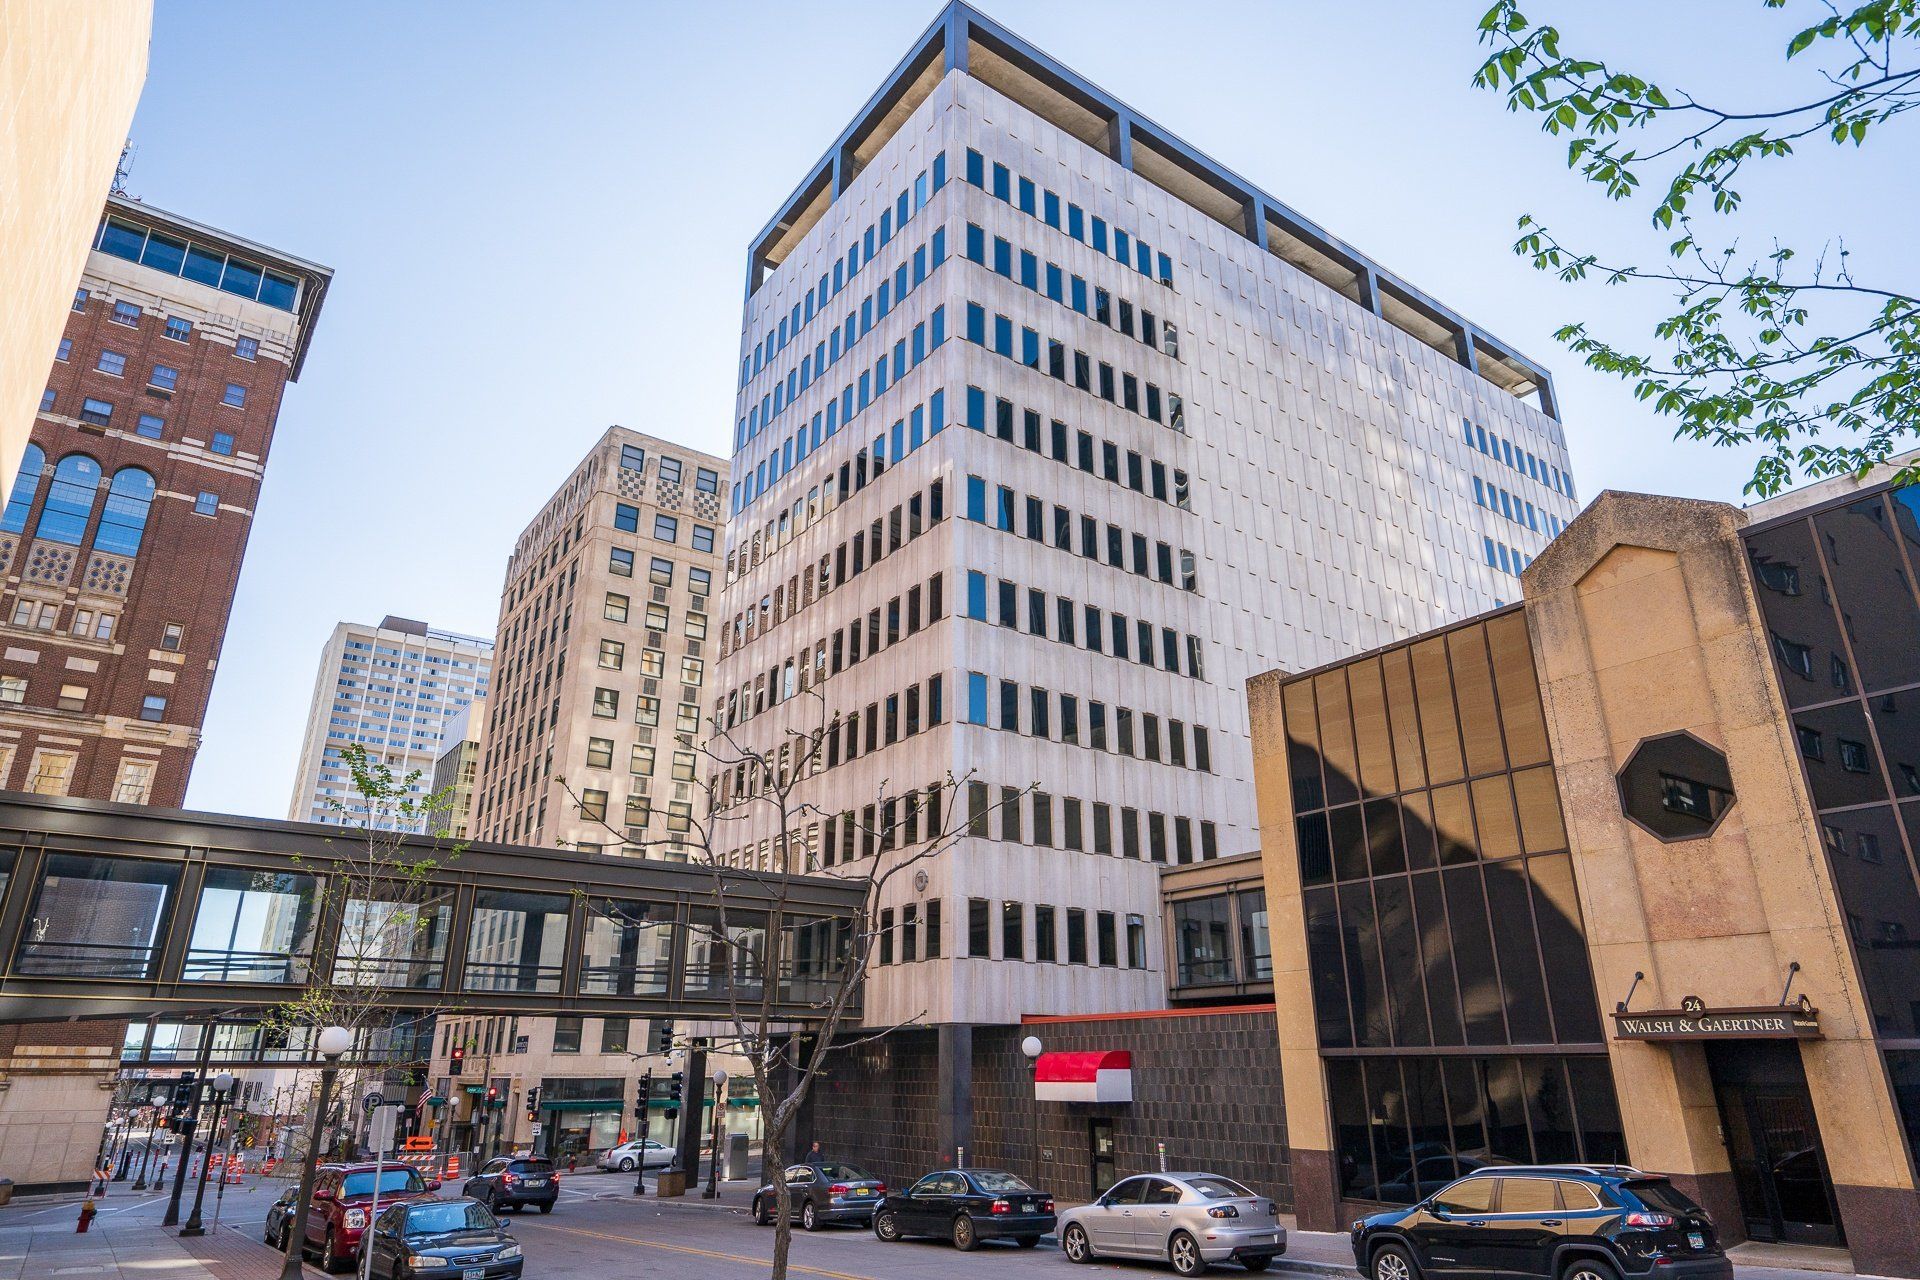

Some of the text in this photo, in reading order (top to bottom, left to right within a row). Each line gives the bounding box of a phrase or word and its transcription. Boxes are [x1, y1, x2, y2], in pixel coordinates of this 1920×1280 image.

[1685, 1000, 1701, 1012] 24
[1621, 1020, 1675, 1034] WALSH
[1679, 1018, 1695, 1032] &
[1698, 1017, 1786, 1032] GAERTNER
[369, 1096, 380, 1109] P
